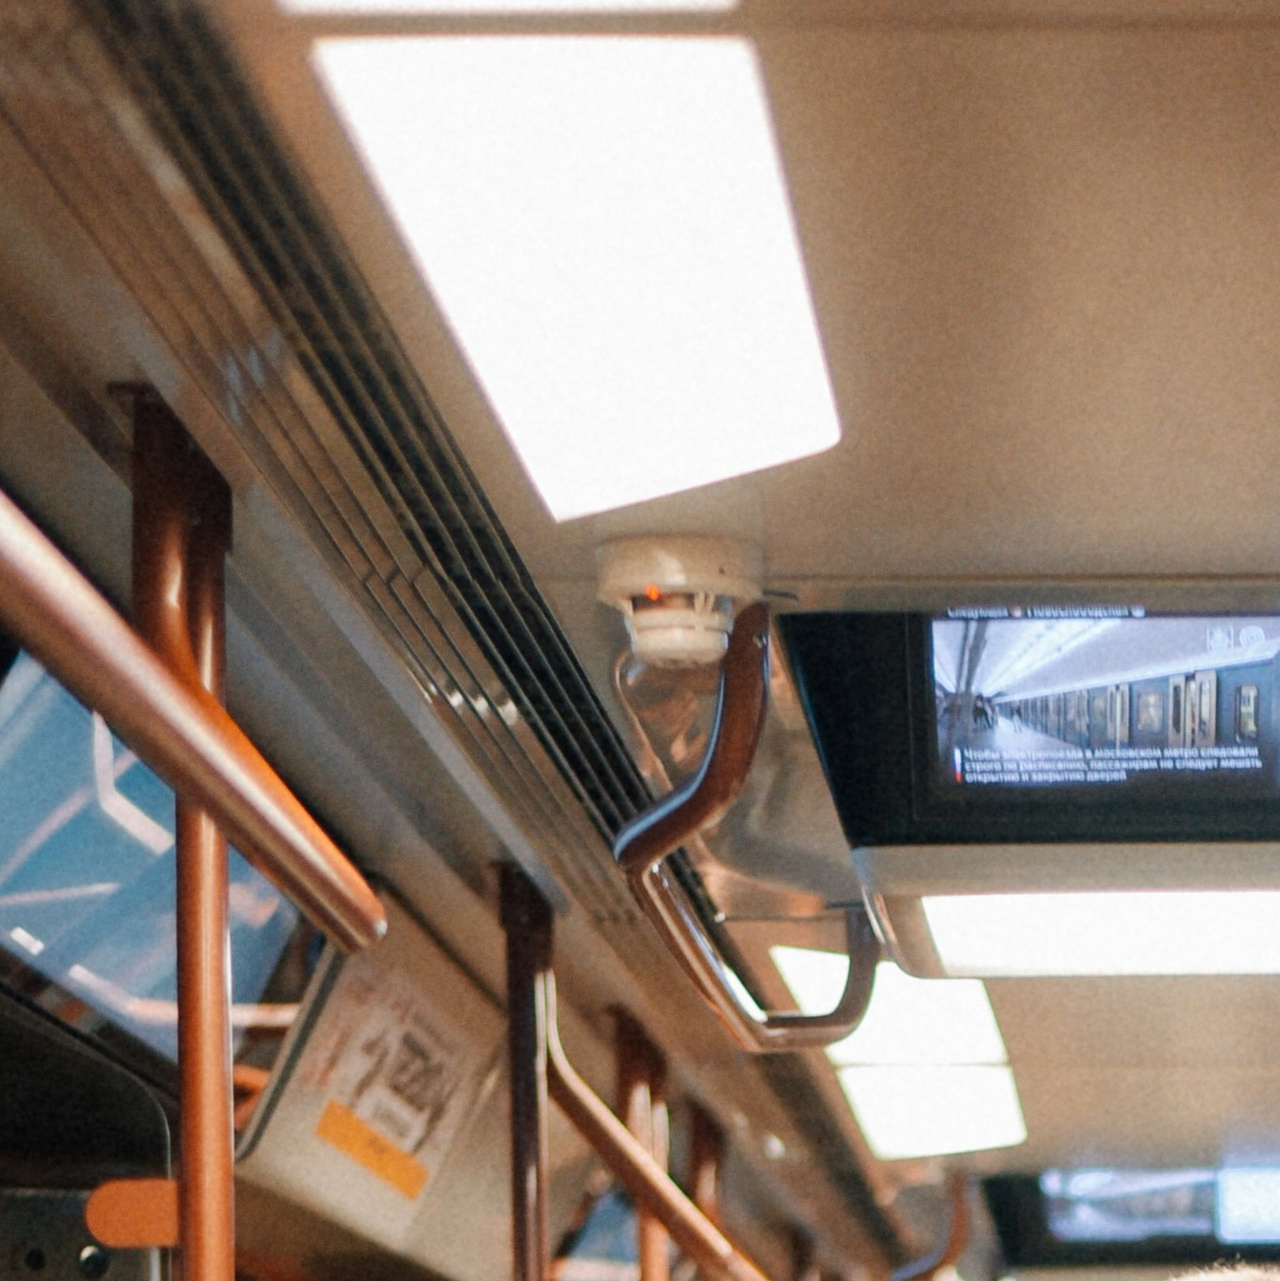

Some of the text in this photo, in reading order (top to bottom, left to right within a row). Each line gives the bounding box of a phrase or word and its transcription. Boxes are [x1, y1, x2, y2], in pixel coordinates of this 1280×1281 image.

[1094, 747, 1162, 759] московском
[1164, 747, 1198, 759] метро
[1200, 746, 1259, 758] следовали
[965, 760, 1001, 772] строго
[1003, 761, 1018, 771] по
[1090, 759, 1158, 771] пассажирам
[1160, 759, 1174, 769] не
[1175, 758, 1218, 771] следует
[1220, 758, 1263, 769] мешать
[965, 772, 1020, 784] открытию
[1086, 769, 1127, 782] дверей
